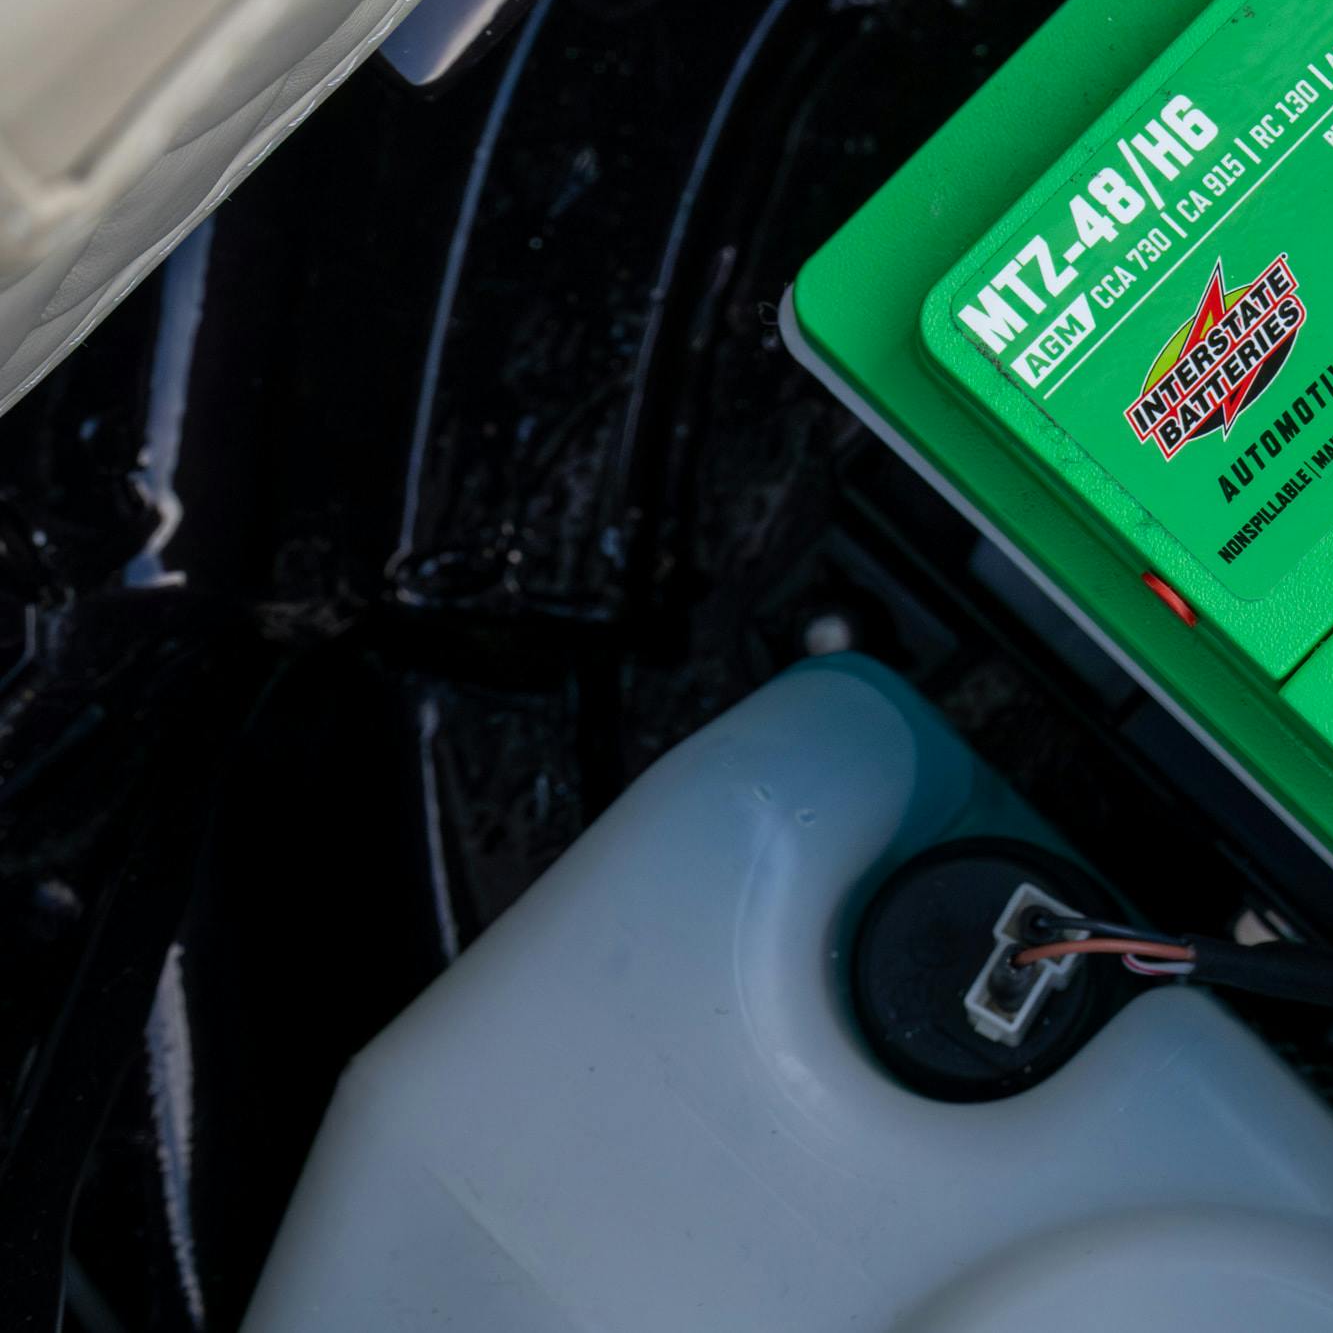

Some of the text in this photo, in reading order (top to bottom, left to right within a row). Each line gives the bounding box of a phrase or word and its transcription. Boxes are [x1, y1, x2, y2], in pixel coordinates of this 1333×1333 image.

[957, 94, 1219, 355] MTZ-48/H6
[1089, 265, 1137, 309] CCA
[1125, 227, 1172, 271] 730
[1176, 190, 1213, 223] CA
[1201, 153, 1246, 197] 915
[1248, 114, 1285, 149] RC
[1274, 79, 1320, 124] 130
[1019, 312, 1088, 380] AGM
[1126, 264, 1298, 435] INTERSTATE
[1151, 295, 1308, 452] BATTERIES
[1217, 468, 1313, 564] NONSPILLABLE
